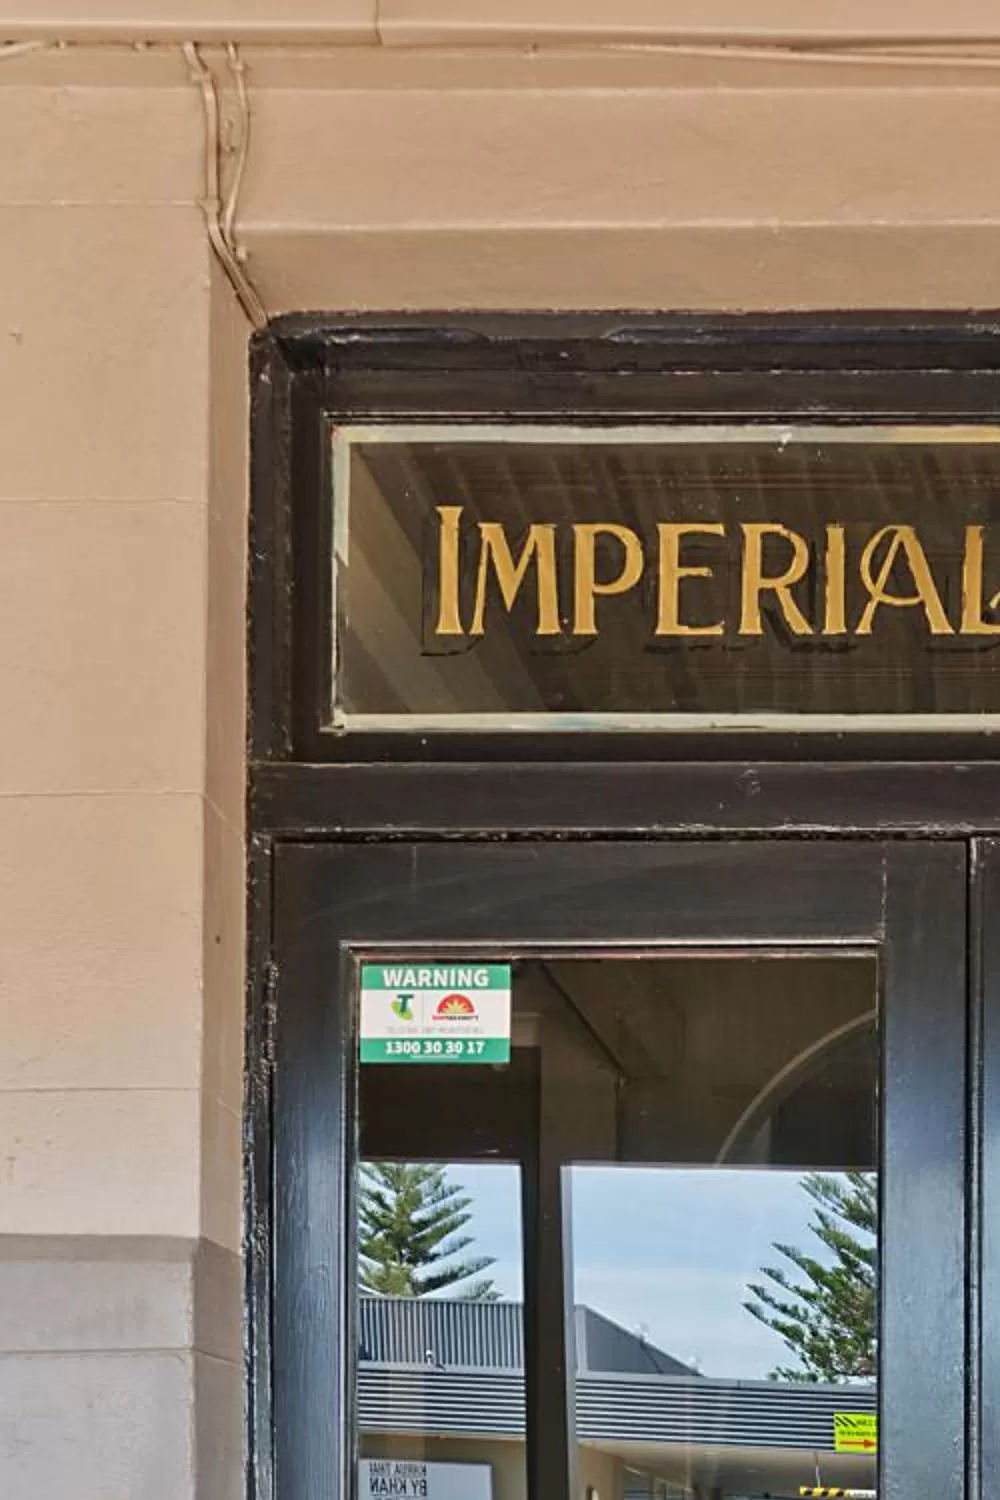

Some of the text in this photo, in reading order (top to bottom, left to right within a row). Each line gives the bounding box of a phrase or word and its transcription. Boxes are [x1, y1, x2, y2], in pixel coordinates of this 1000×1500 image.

[382, 968, 489, 987] WARNING
[385, 1041, 485, 1054] 1300 30 30 17
